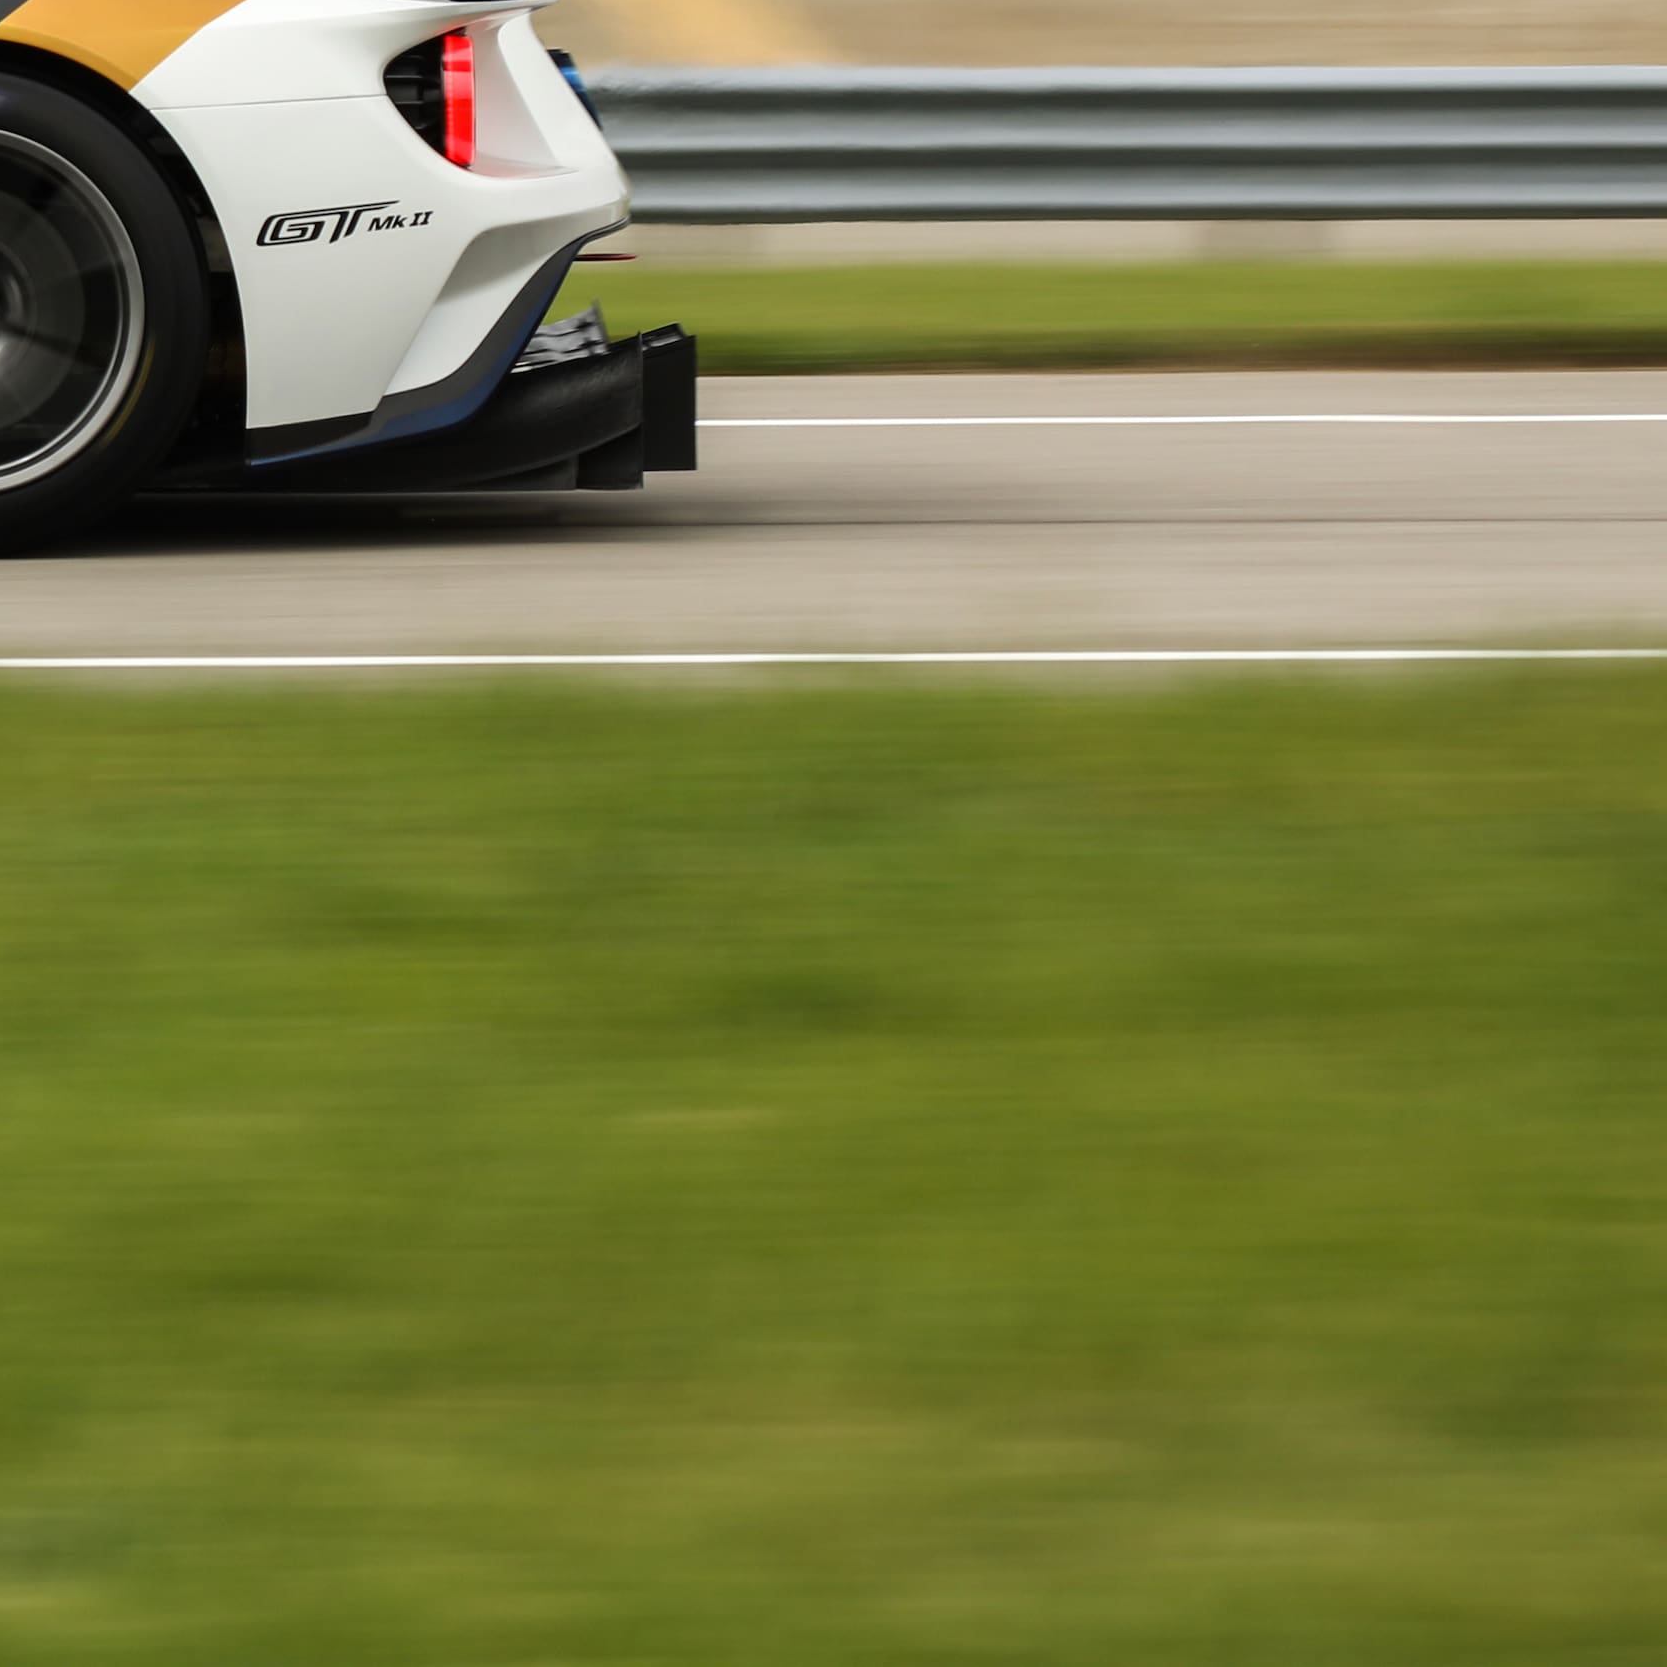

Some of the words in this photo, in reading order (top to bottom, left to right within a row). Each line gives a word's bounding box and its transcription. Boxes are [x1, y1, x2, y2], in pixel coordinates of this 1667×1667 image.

[256, 199, 400, 246] GT
[367, 214, 408, 232] Mk
[409, 210, 434, 227] II
